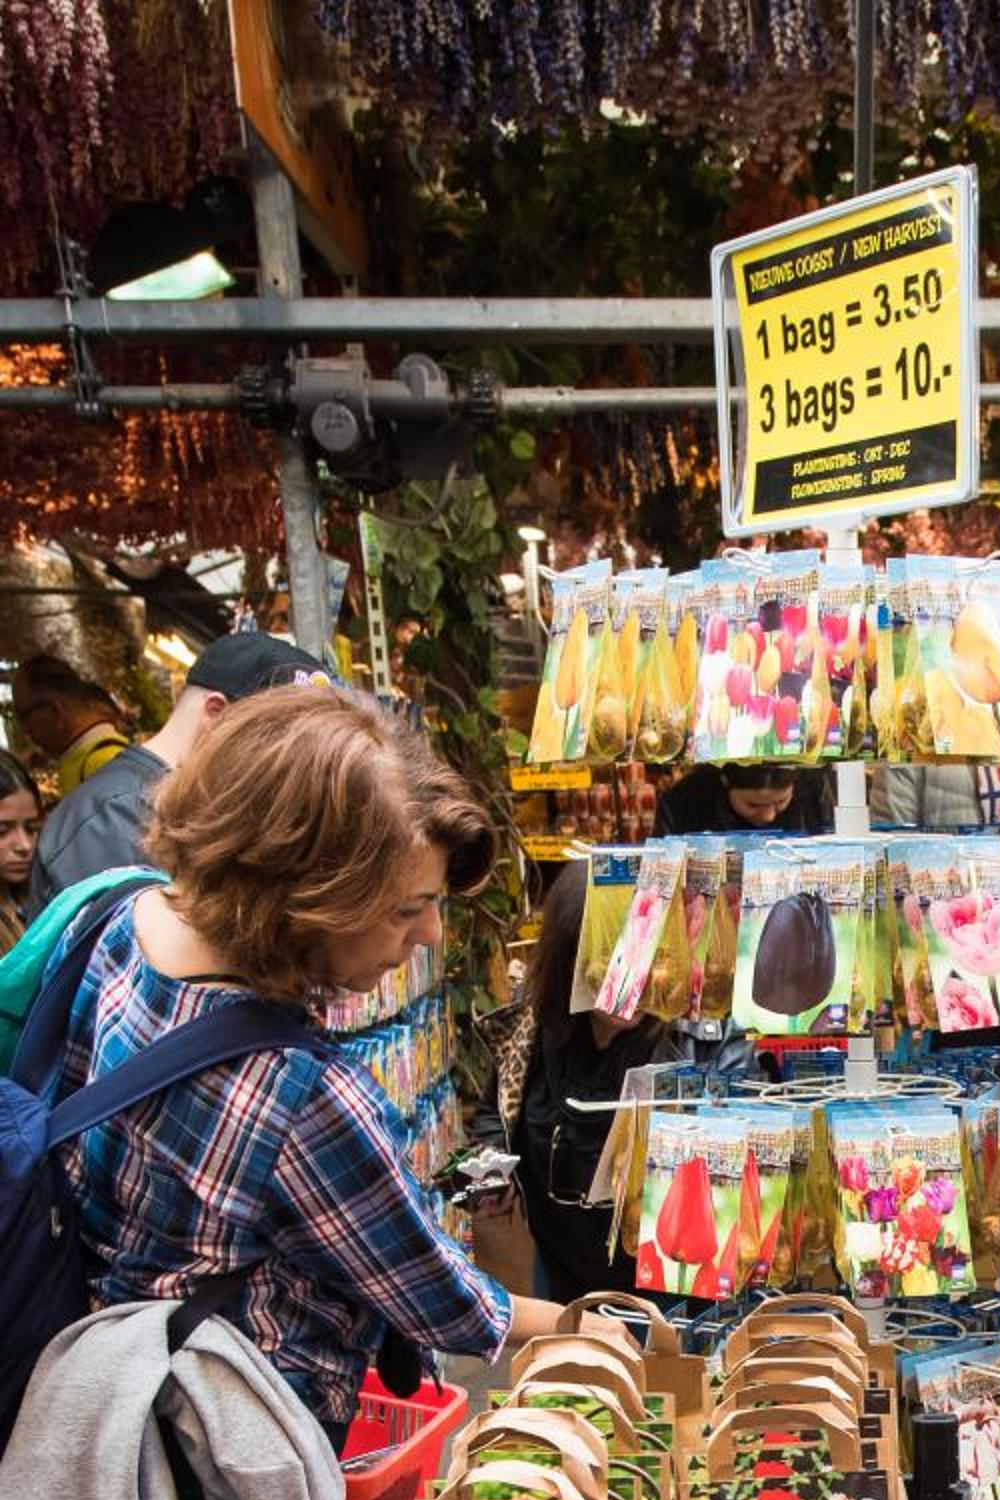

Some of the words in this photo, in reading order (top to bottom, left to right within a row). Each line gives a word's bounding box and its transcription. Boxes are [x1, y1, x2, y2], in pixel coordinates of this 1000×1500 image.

[750, 260, 794, 293] NIEUWE
[795, 247, 835, 281] OOGST
[852, 234, 882, 259] NEW
[883, 213, 944, 249] HARVEST
[756, 319, 770, 360] 1
[781, 309, 836, 354] bag
[873, 267, 943, 328] 3.50
[759, 383, 776, 433] 3
[785, 375, 855, 432] bags
[895, 342, 953, 401] 10.-
